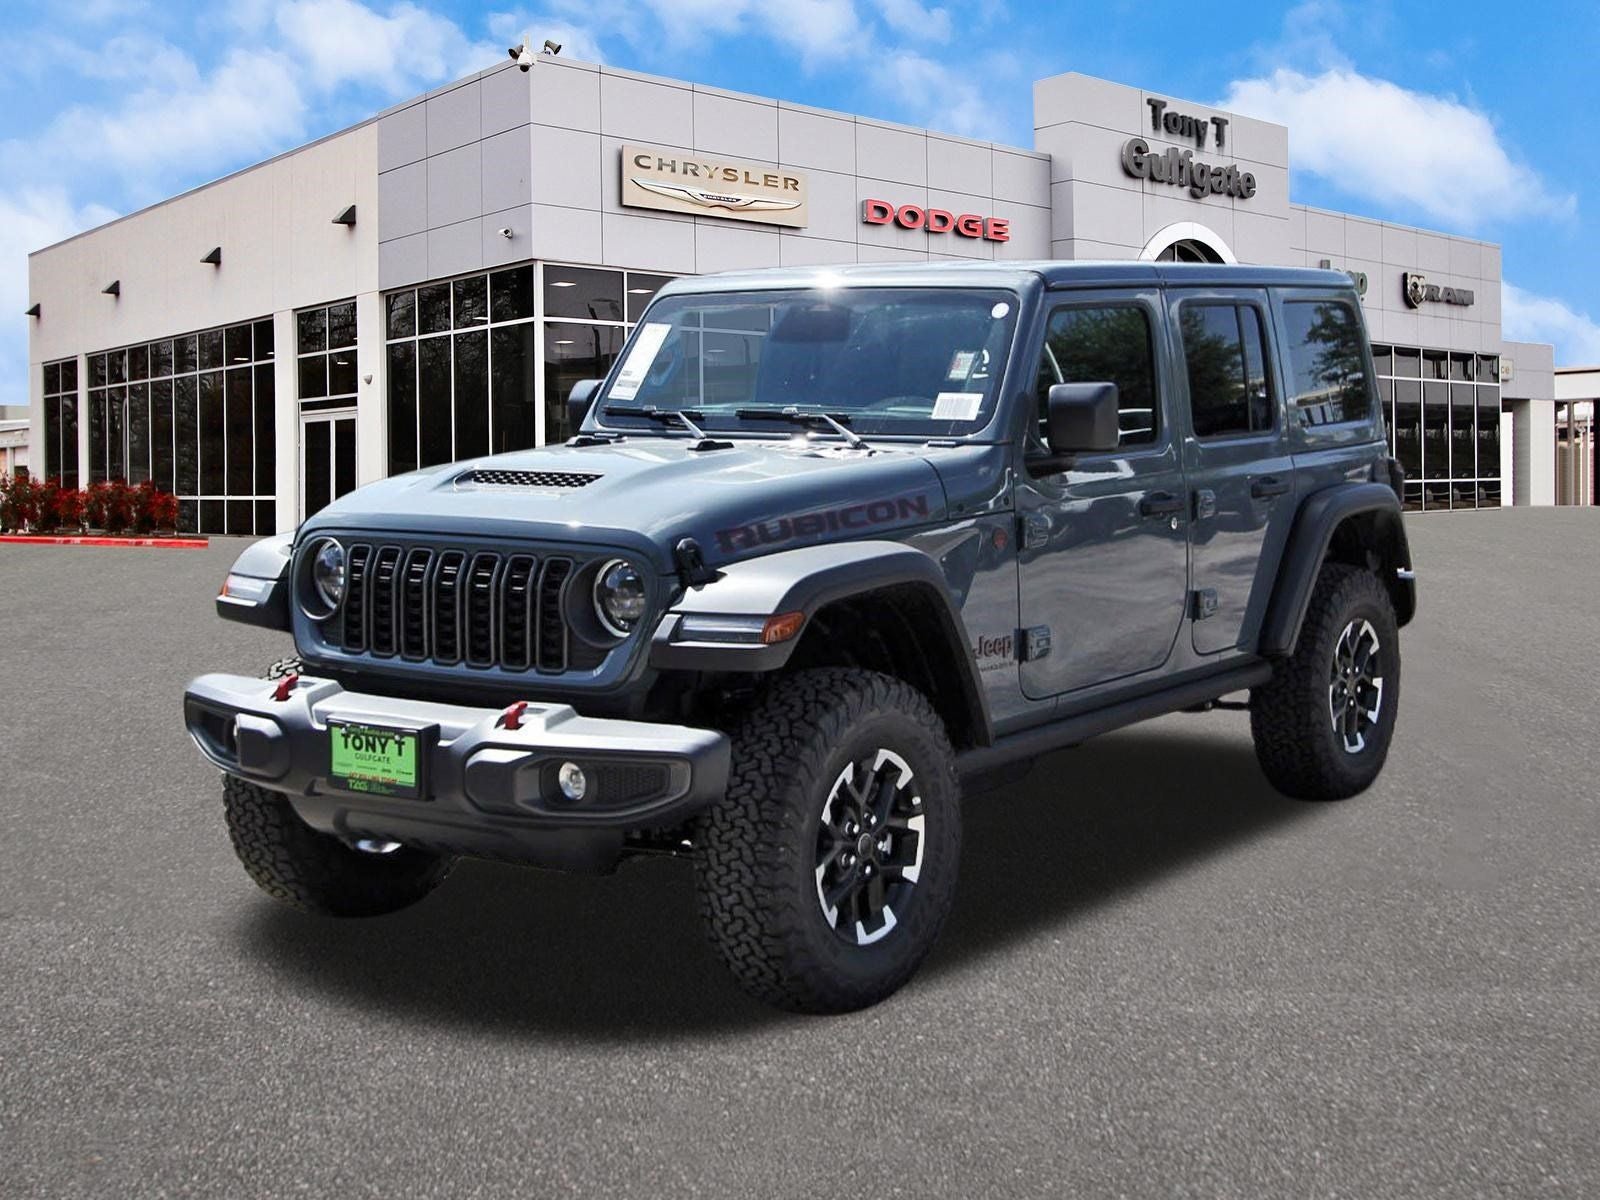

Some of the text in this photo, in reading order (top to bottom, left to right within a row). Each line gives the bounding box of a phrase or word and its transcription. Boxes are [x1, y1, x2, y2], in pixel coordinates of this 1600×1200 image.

[1147, 98, 1229, 147] Tony T
[634, 154, 800, 192] CHRYSLER
[1121, 138, 1256, 199] Gulfgate
[863, 198, 1010, 243] DODGE
[1425, 284, 1475, 306] RAM
[715, 494, 929, 552] RUBICON
[972, 634, 1011, 659] Jeep
[341, 732, 389, 754] TONY
[394, 738, 405, 757] T
[355, 753, 391, 764] GULFGATE
